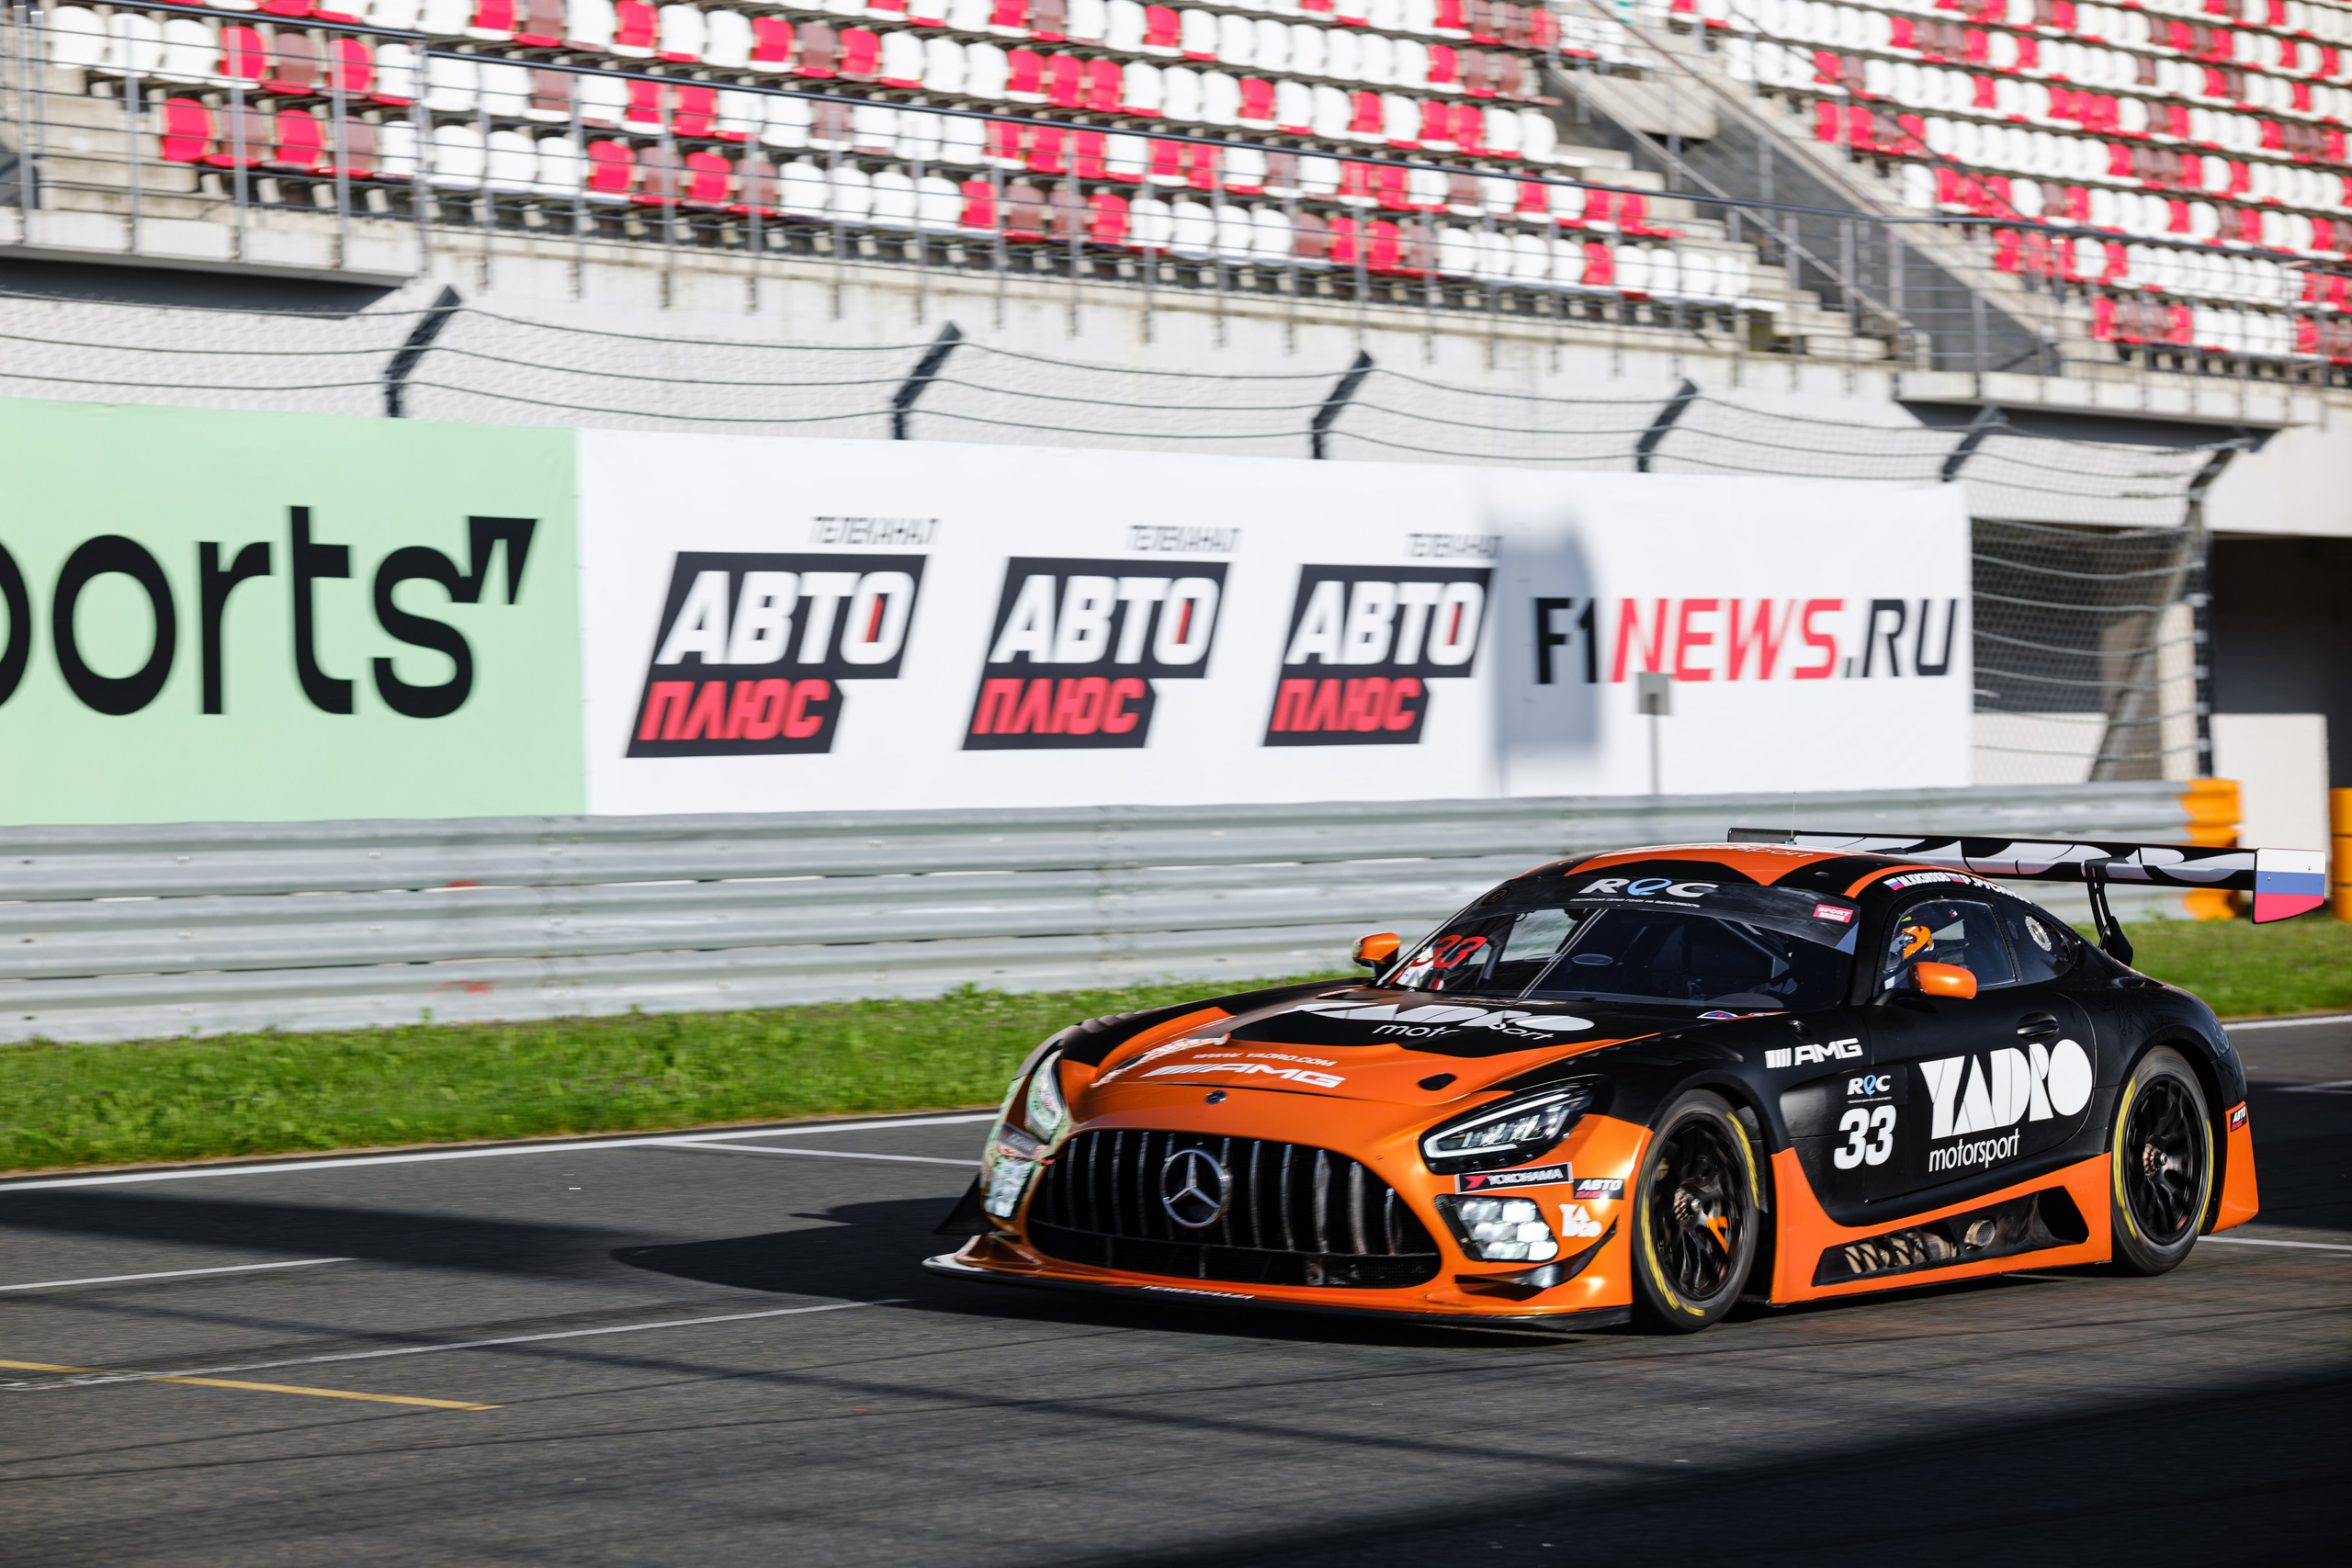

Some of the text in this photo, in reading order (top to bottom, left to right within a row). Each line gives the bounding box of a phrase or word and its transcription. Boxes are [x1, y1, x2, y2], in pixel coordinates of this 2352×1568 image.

[653, 570, 916, 665] АВТО
[987, 574, 1220, 665] АВТО
[1283, 581, 1486, 665] АВТО
[1532, 596, 1961, 684] F1NEWS.RU
[636, 678, 832, 740] ПЛЮС
[970, 677, 1148, 735] ПЛЮС
[1269, 677, 1423, 732] ПЛЮС
[1817, 907, 1851, 917] SPORT
[1408, 934, 1488, 969] 33
[1202, 1063, 1347, 1089] AMG
[1794, 1037, 1863, 1066] AMG
[1918, 1039, 2093, 1140] YADRO
[1833, 1104, 1897, 1170] 33
[1928, 1128, 2020, 1172] motorsport
[1487, 1168, 1564, 1186] YOKOHAMA
[1577, 1179, 1623, 1191] АВТО
